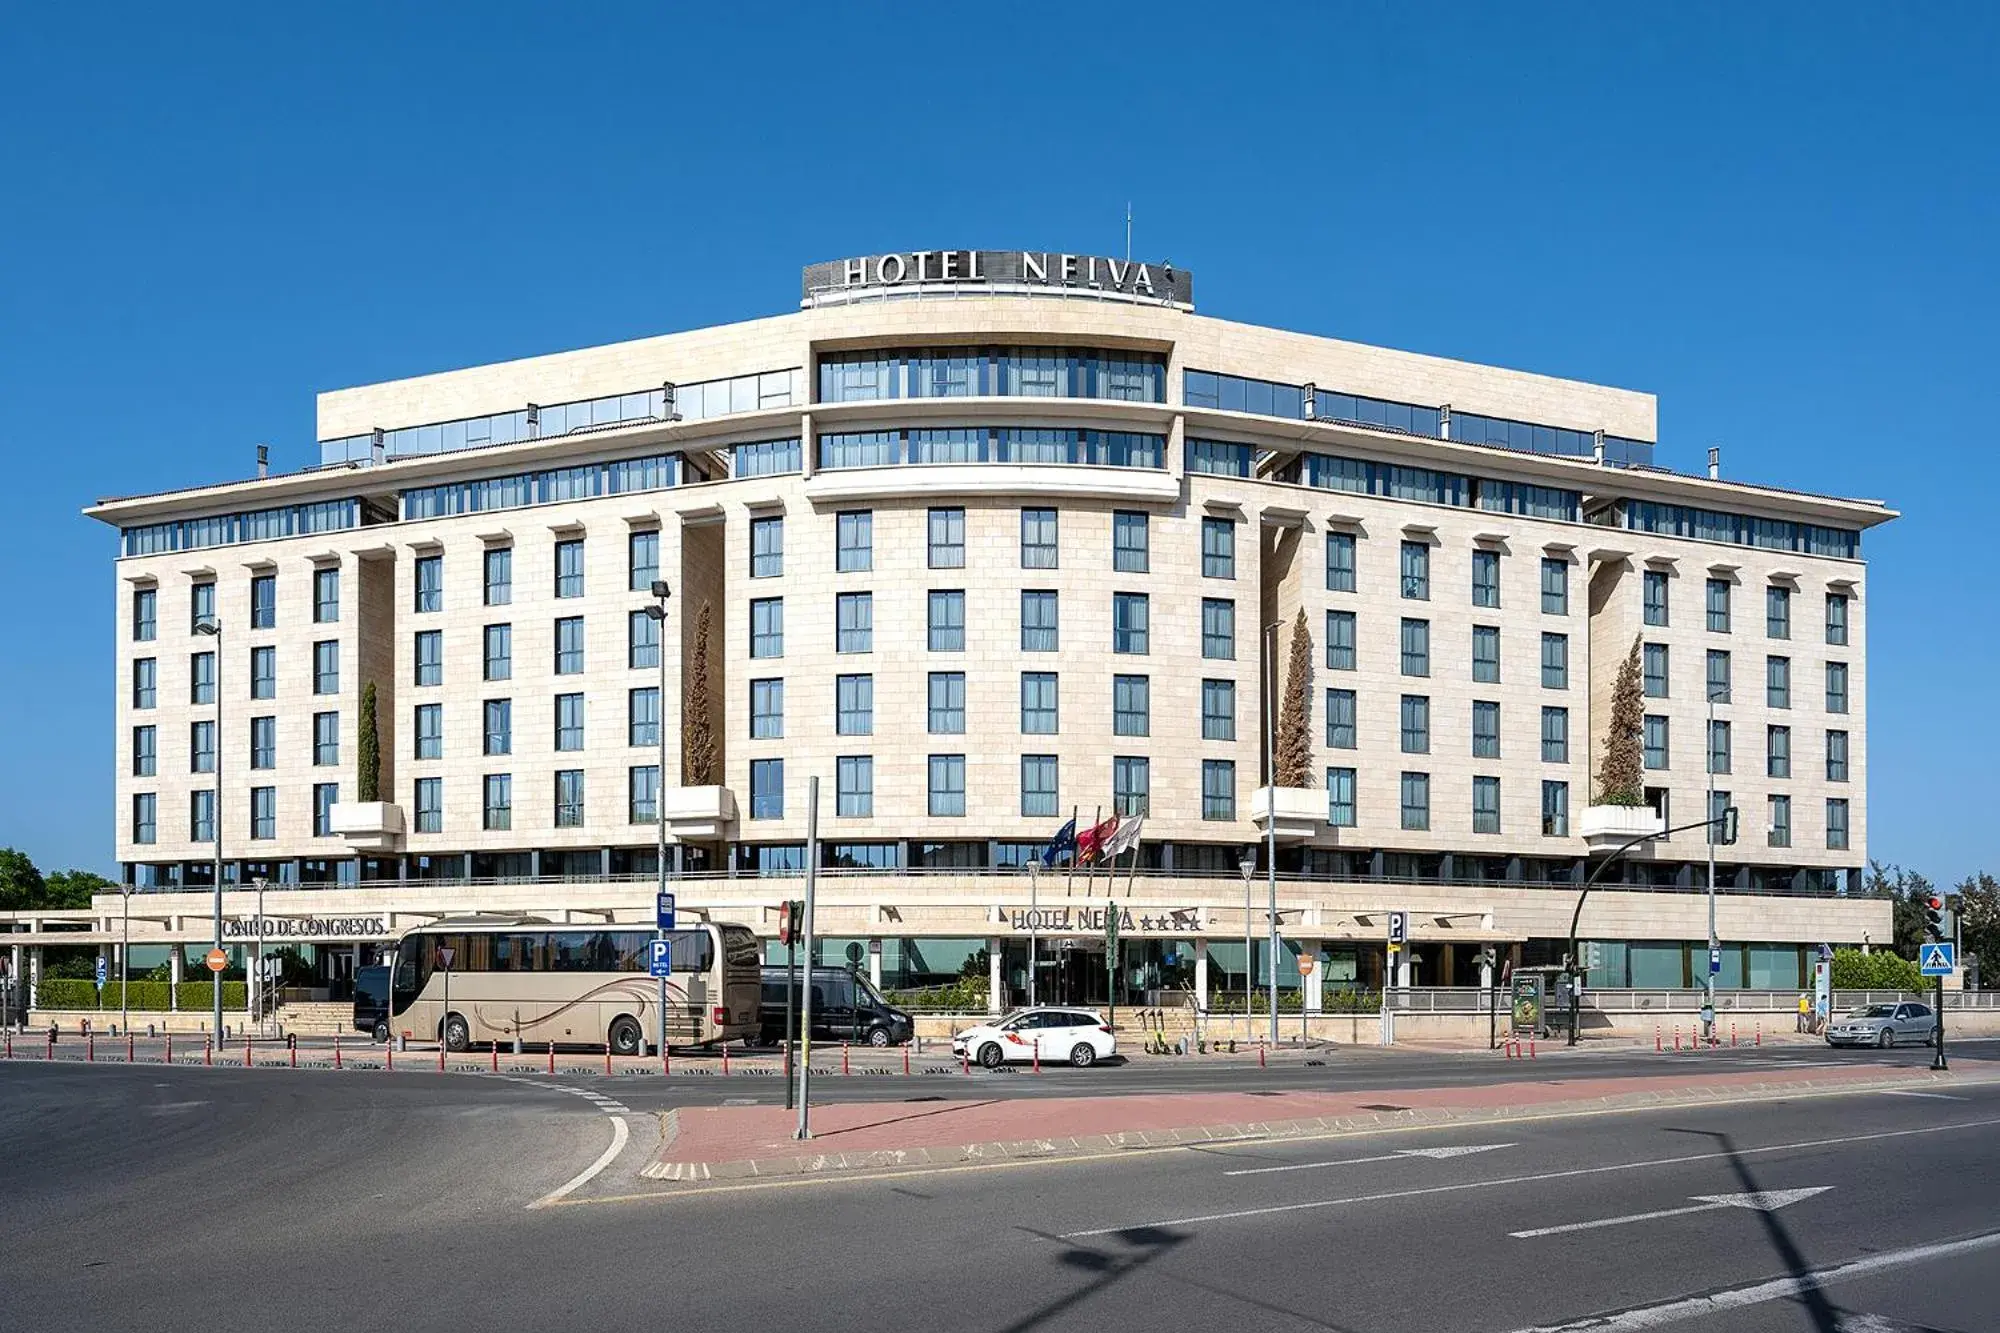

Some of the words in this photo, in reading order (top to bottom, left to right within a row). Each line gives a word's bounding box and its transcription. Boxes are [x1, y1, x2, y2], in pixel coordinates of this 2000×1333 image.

[844, 250, 984, 288] HOTEL
[1023, 251, 1154, 294] NELVA
[277, 919, 297, 936] DE
[299, 917, 385, 936] CONGRESOS
[1012, 909, 1073, 930] HOTEL
[1391, 914, 1401, 937] P
[654, 943, 667, 962] P
[98, 957, 105, 969] P
